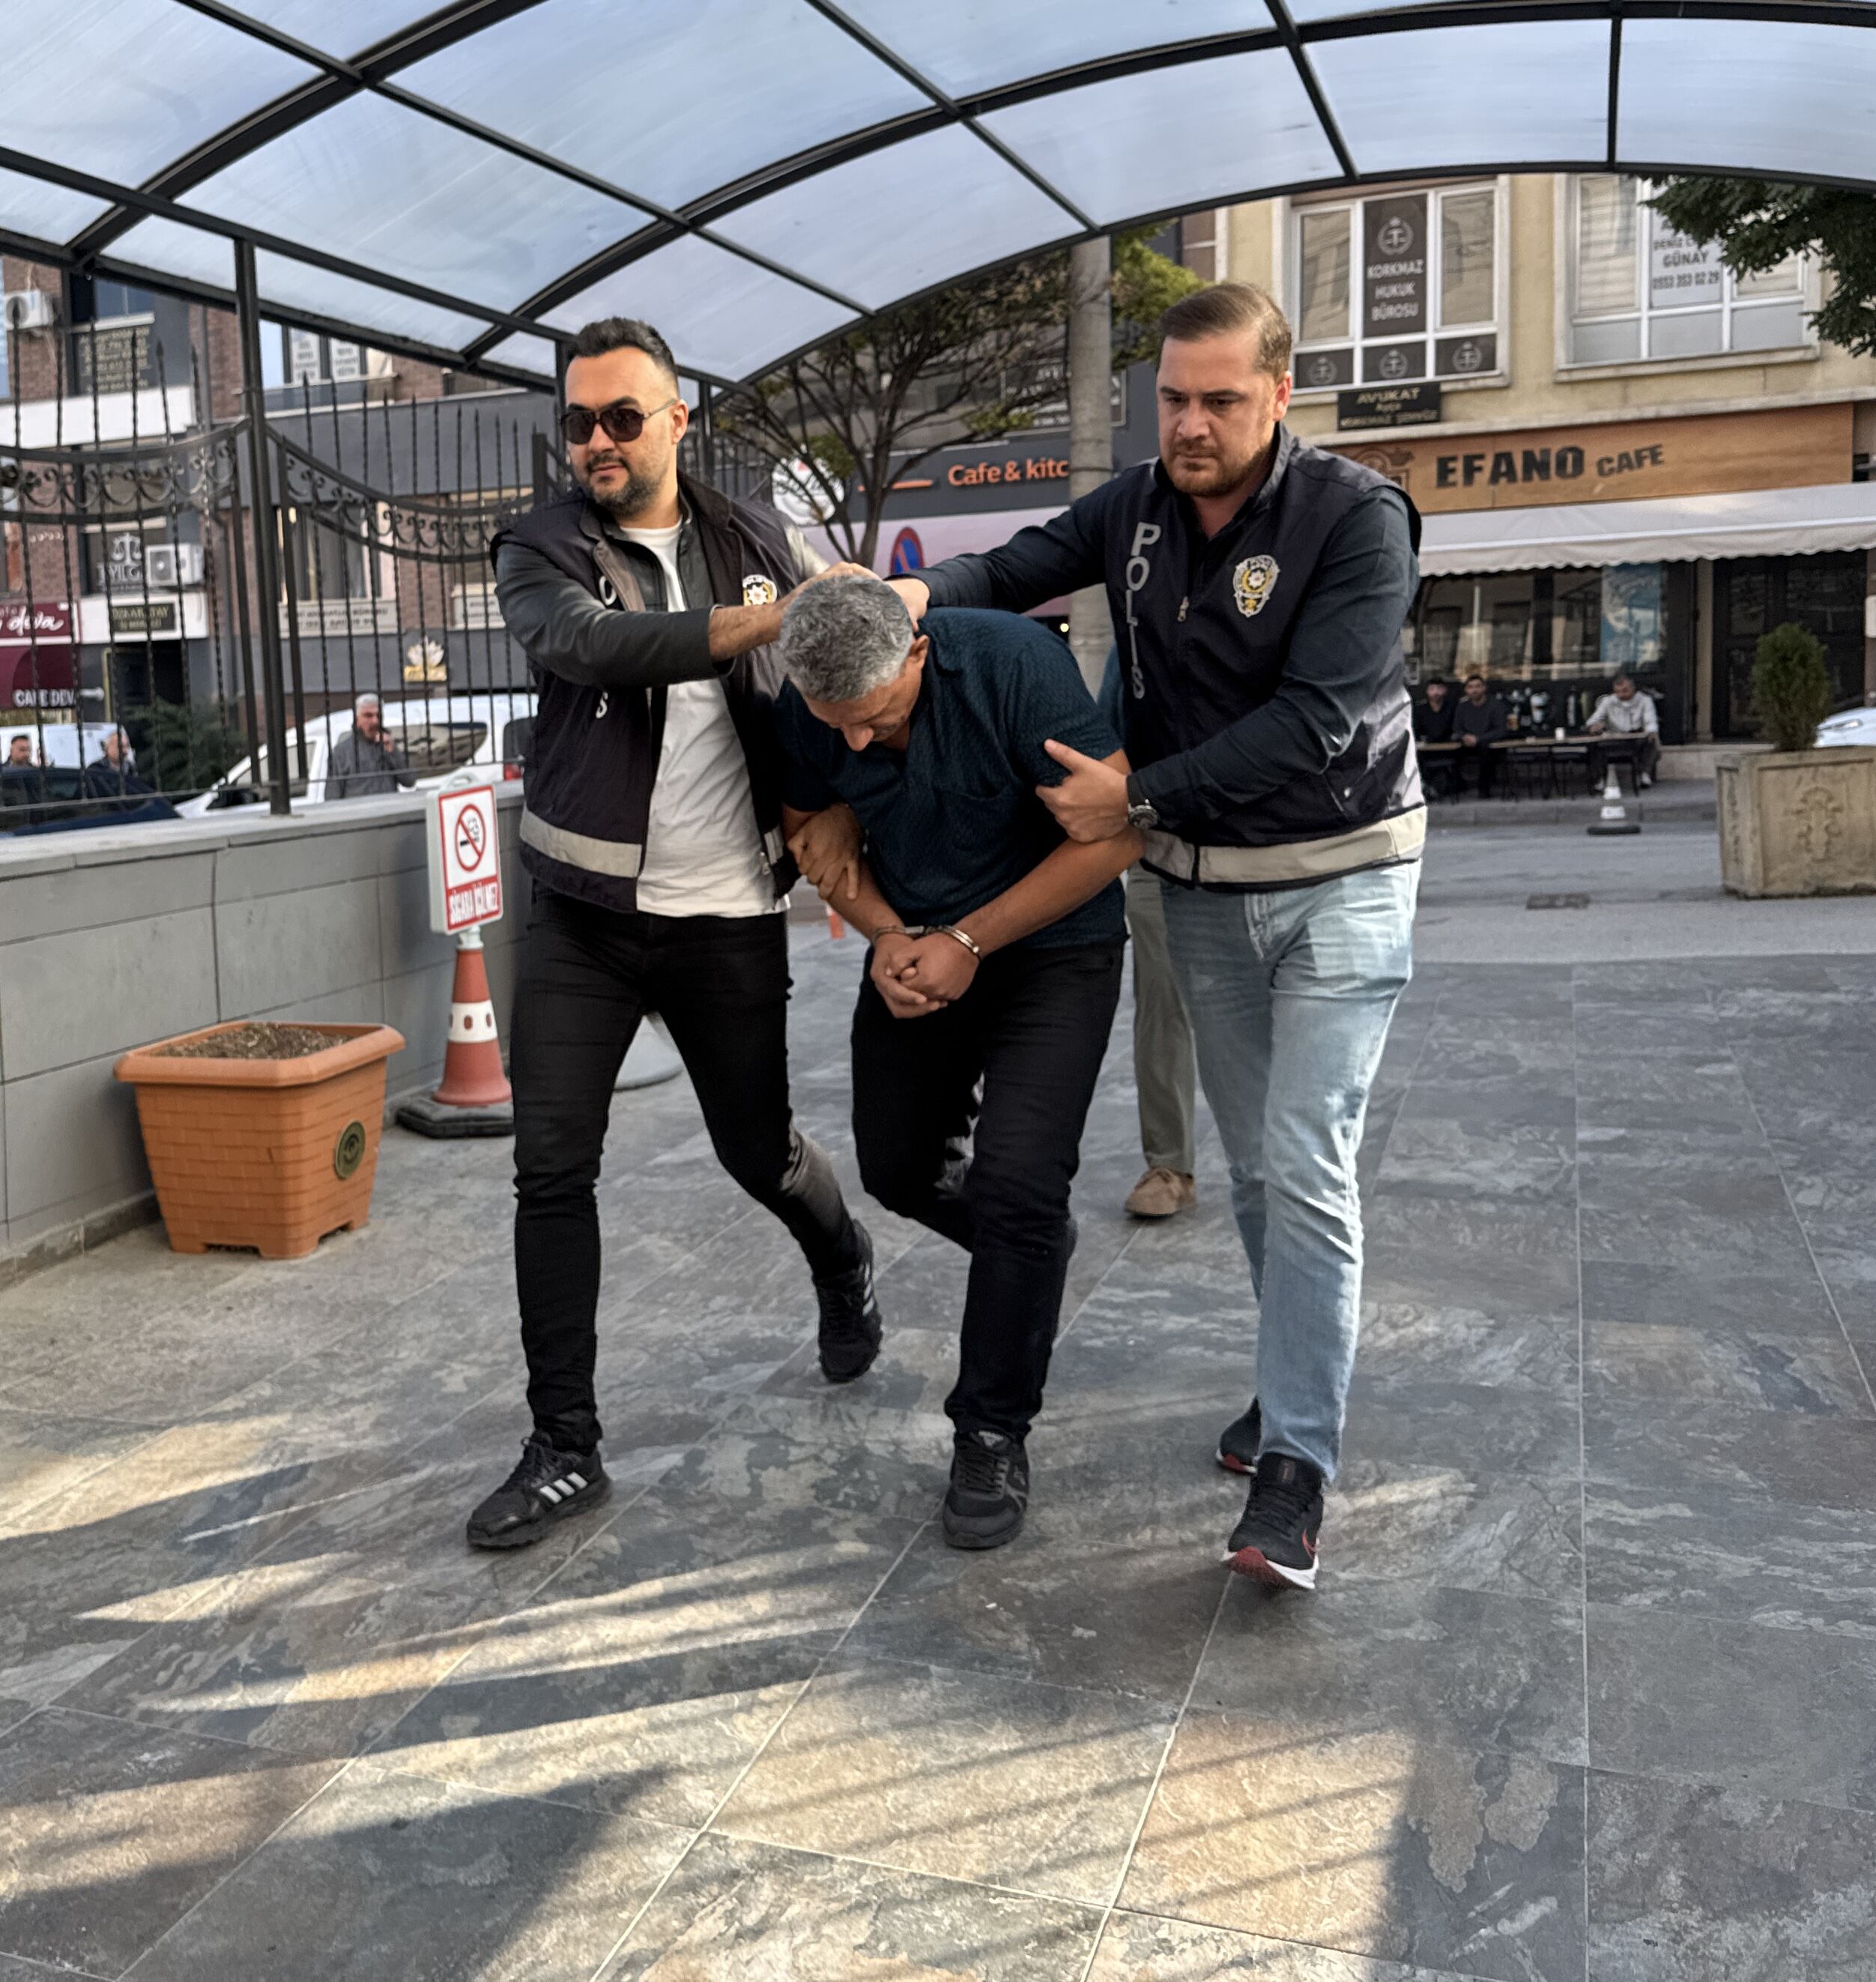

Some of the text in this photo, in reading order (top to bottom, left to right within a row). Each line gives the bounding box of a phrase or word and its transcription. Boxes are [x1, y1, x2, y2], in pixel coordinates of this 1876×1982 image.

[1662, 251, 1708, 267] GÜNAY
[1367, 258, 1423, 280] KORKMAZ
[1375, 281, 1415, 300] HUKUK
[1372, 302, 1419, 321] BÜROSU
[1357, 387, 1420, 405] AVUKAT
[948, 461, 1001, 486] Cafe
[1004, 460, 1021, 482] &
[1435, 444, 1665, 488] EFANO CAFE
